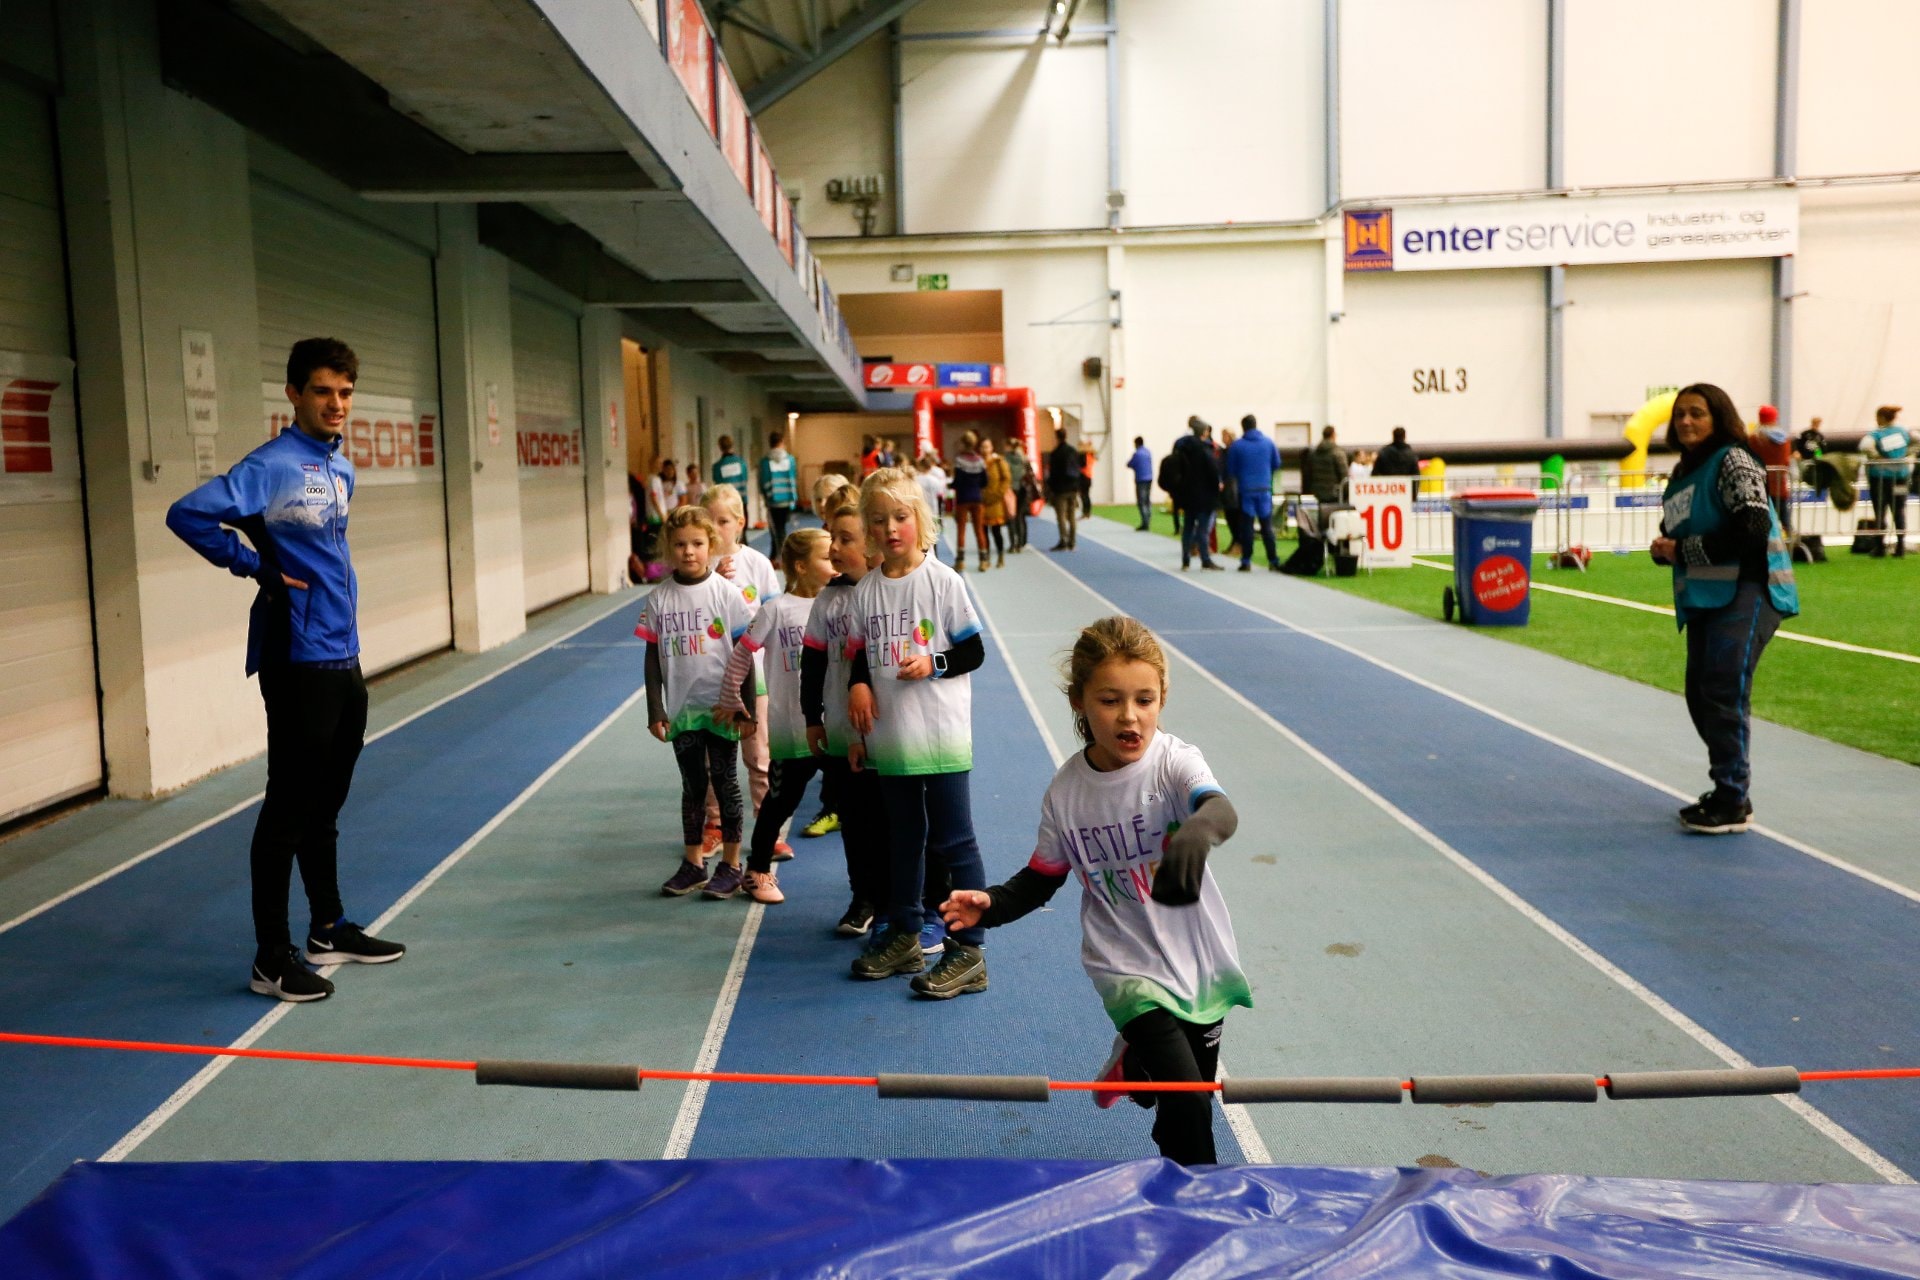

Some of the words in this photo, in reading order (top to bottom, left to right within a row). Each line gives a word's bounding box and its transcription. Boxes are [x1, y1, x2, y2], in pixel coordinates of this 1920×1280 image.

[1740, 209, 1766, 226] og
[1403, 222, 1499, 253] enter
[1505, 214, 1635, 250] service
[1413, 369, 1449, 393] SAL
[1456, 368, 1468, 392] 3
[516, 431, 571, 467] NDSOR
[306, 487, 326, 495] coop
[1355, 483, 1406, 496] STASJON
[1360, 504, 1403, 550] 10
[662, 635, 707, 658] EKENE
